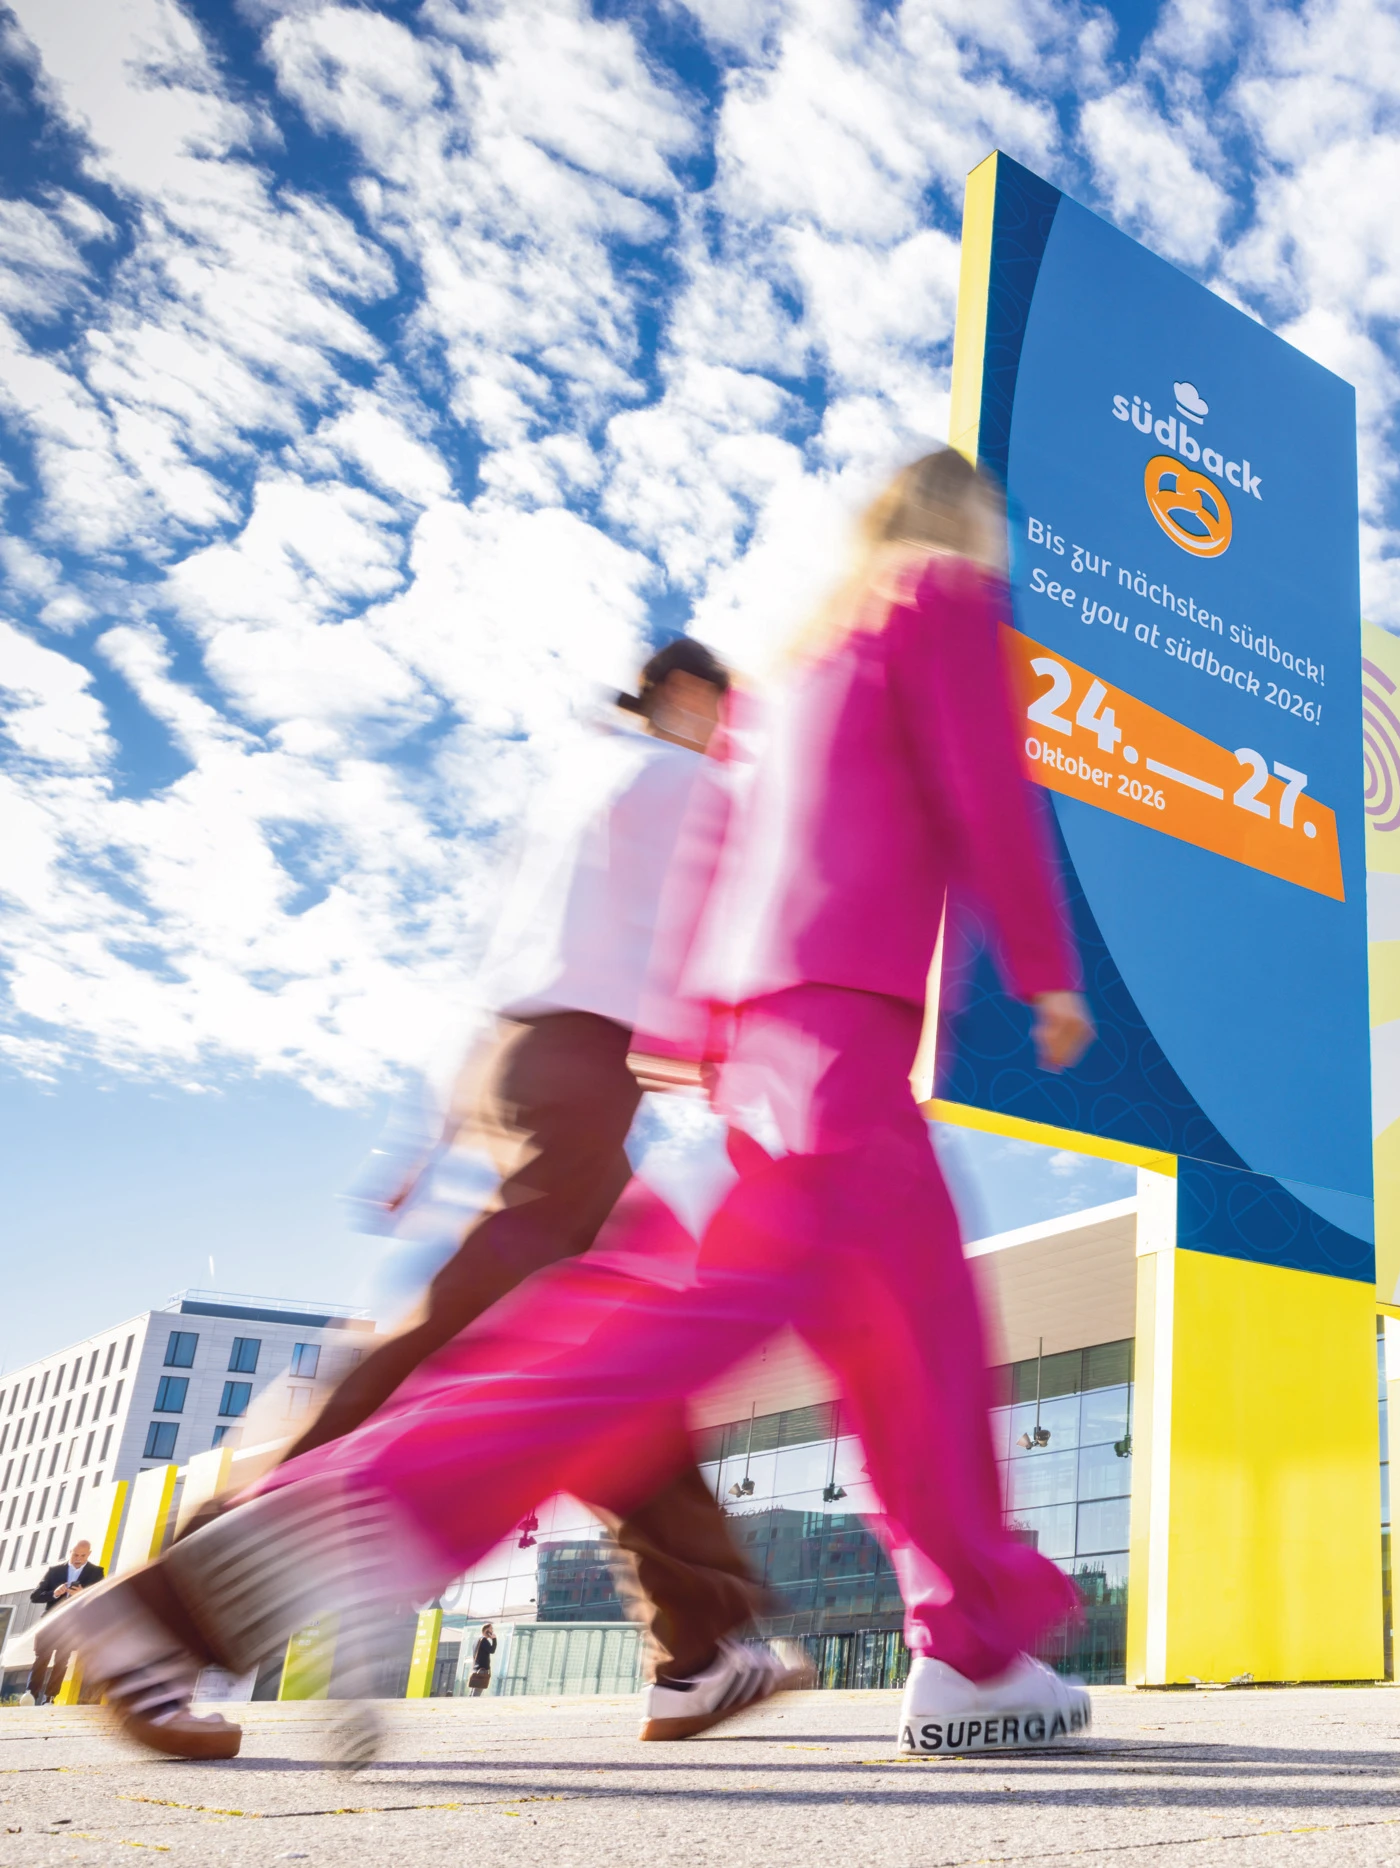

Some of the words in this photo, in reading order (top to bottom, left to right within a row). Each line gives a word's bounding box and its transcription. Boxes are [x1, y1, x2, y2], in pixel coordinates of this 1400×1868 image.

[1111, 394, 1263, 501] südback
[1027, 516, 1065, 556] Bis
[1071, 543, 1111, 578] zur
[1118, 567, 1224, 636] nächsten
[1229, 624, 1326, 688] südback!
[1029, 568, 1077, 608] See
[1081, 597, 1129, 633] you
[1134, 623, 1161, 650] at
[1164, 636, 1260, 697] südback
[1264, 682, 1323, 726] 2026!
[1024, 736, 1113, 789] Oktober
[1117, 774, 1166, 811] 2026
